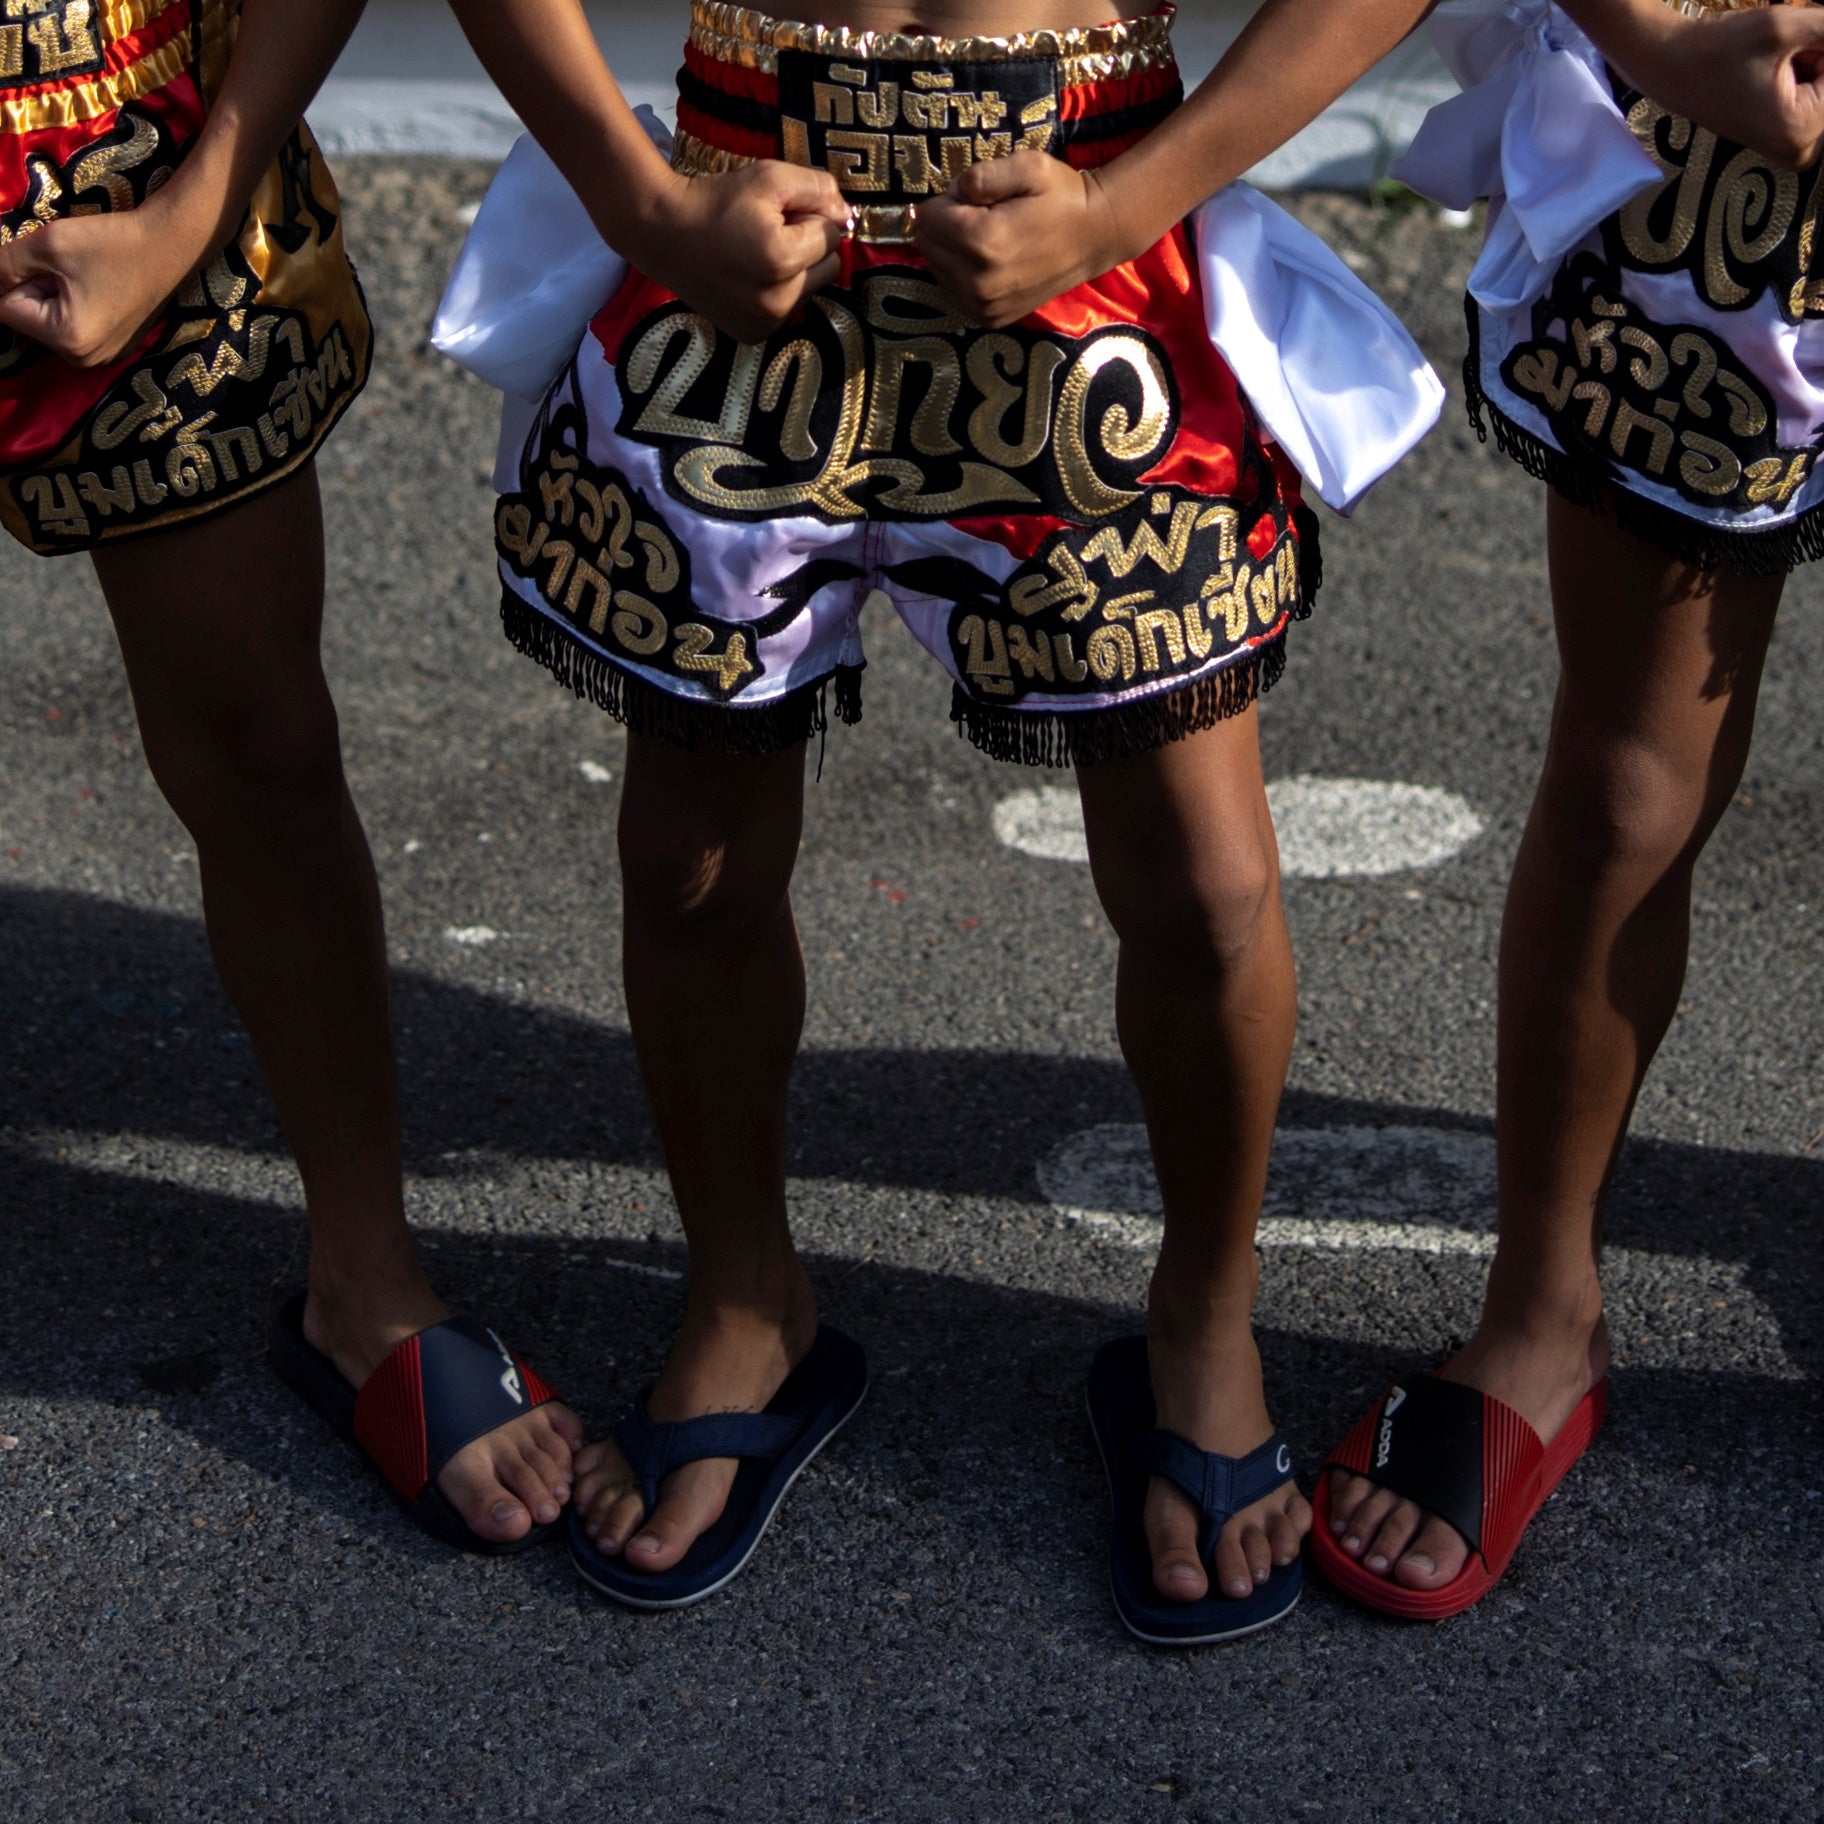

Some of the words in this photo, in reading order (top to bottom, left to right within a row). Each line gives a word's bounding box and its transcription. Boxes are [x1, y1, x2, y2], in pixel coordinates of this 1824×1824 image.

[812, 62, 1007, 129] กัปตัน
[1513, 348, 1806, 502] มาก่อน
[1571, 293, 1767, 437] หัวใจ
[539, 449, 679, 593] หัวใจ
[498, 504, 754, 691] มาก่อน
[1376, 1418, 1393, 1469] ADDA
